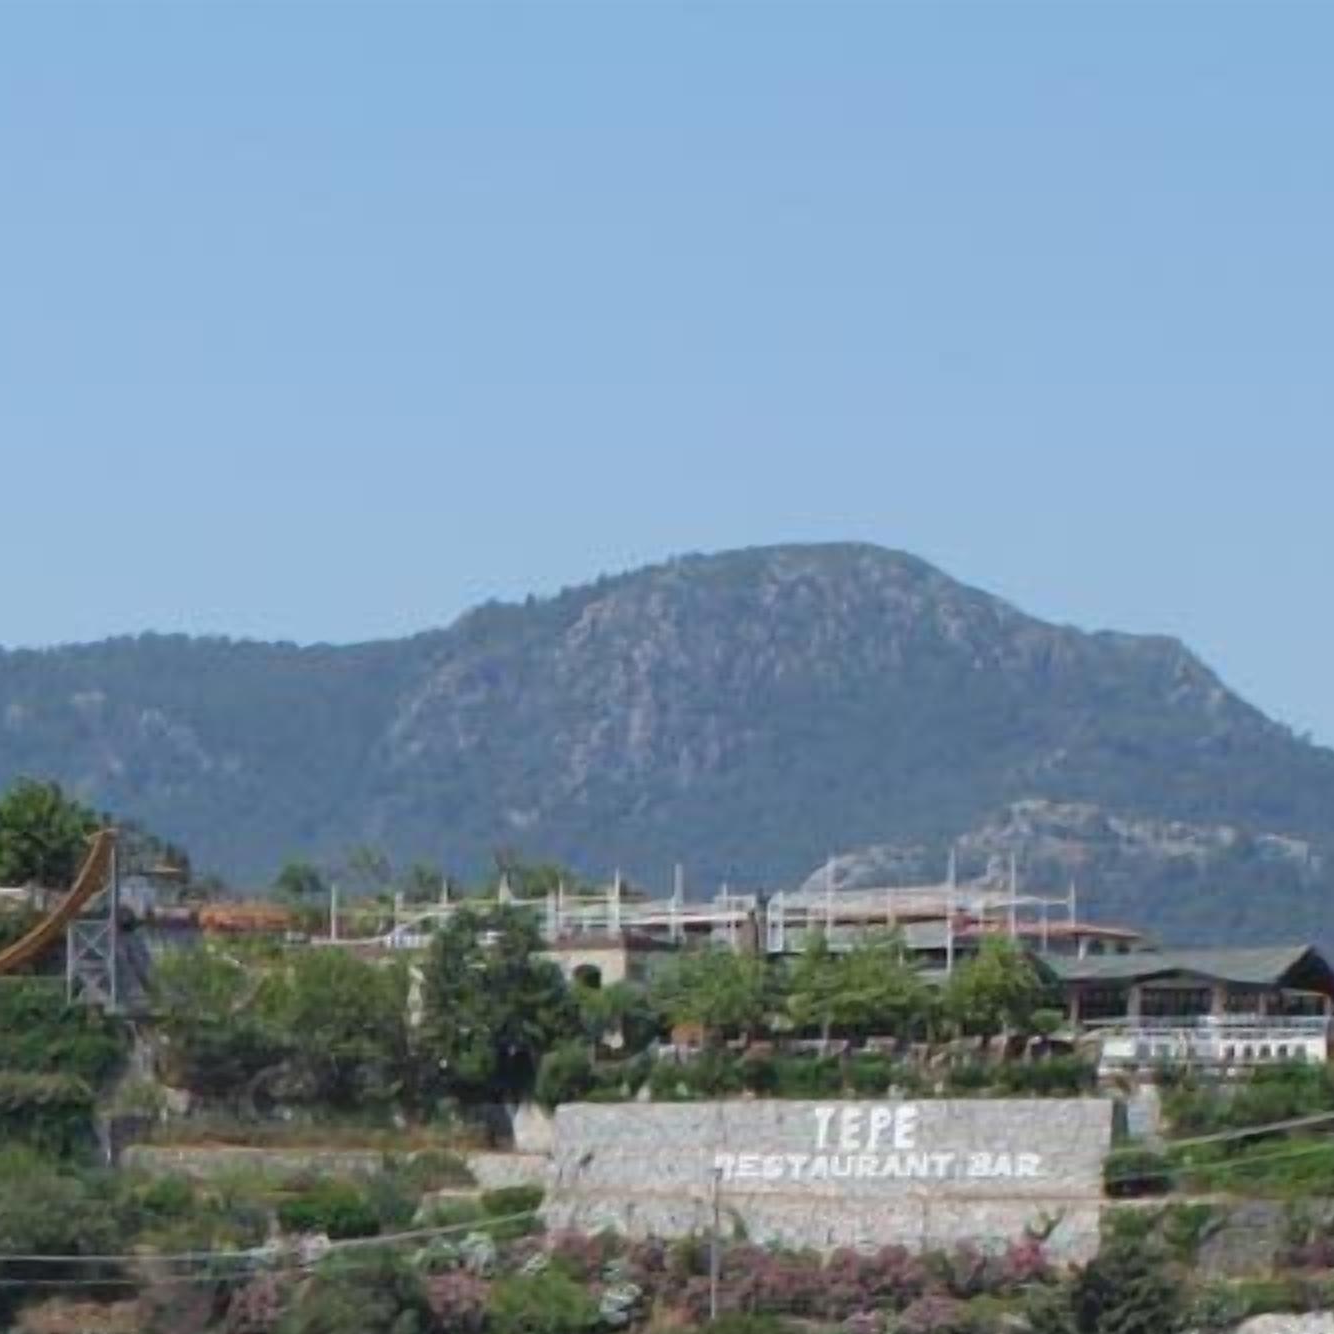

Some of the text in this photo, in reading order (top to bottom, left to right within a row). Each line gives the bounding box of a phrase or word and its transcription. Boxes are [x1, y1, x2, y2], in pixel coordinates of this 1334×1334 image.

[815, 1106, 919, 1150] TEPE
[715, 1152, 1042, 1182] RESTAURANT BAR
